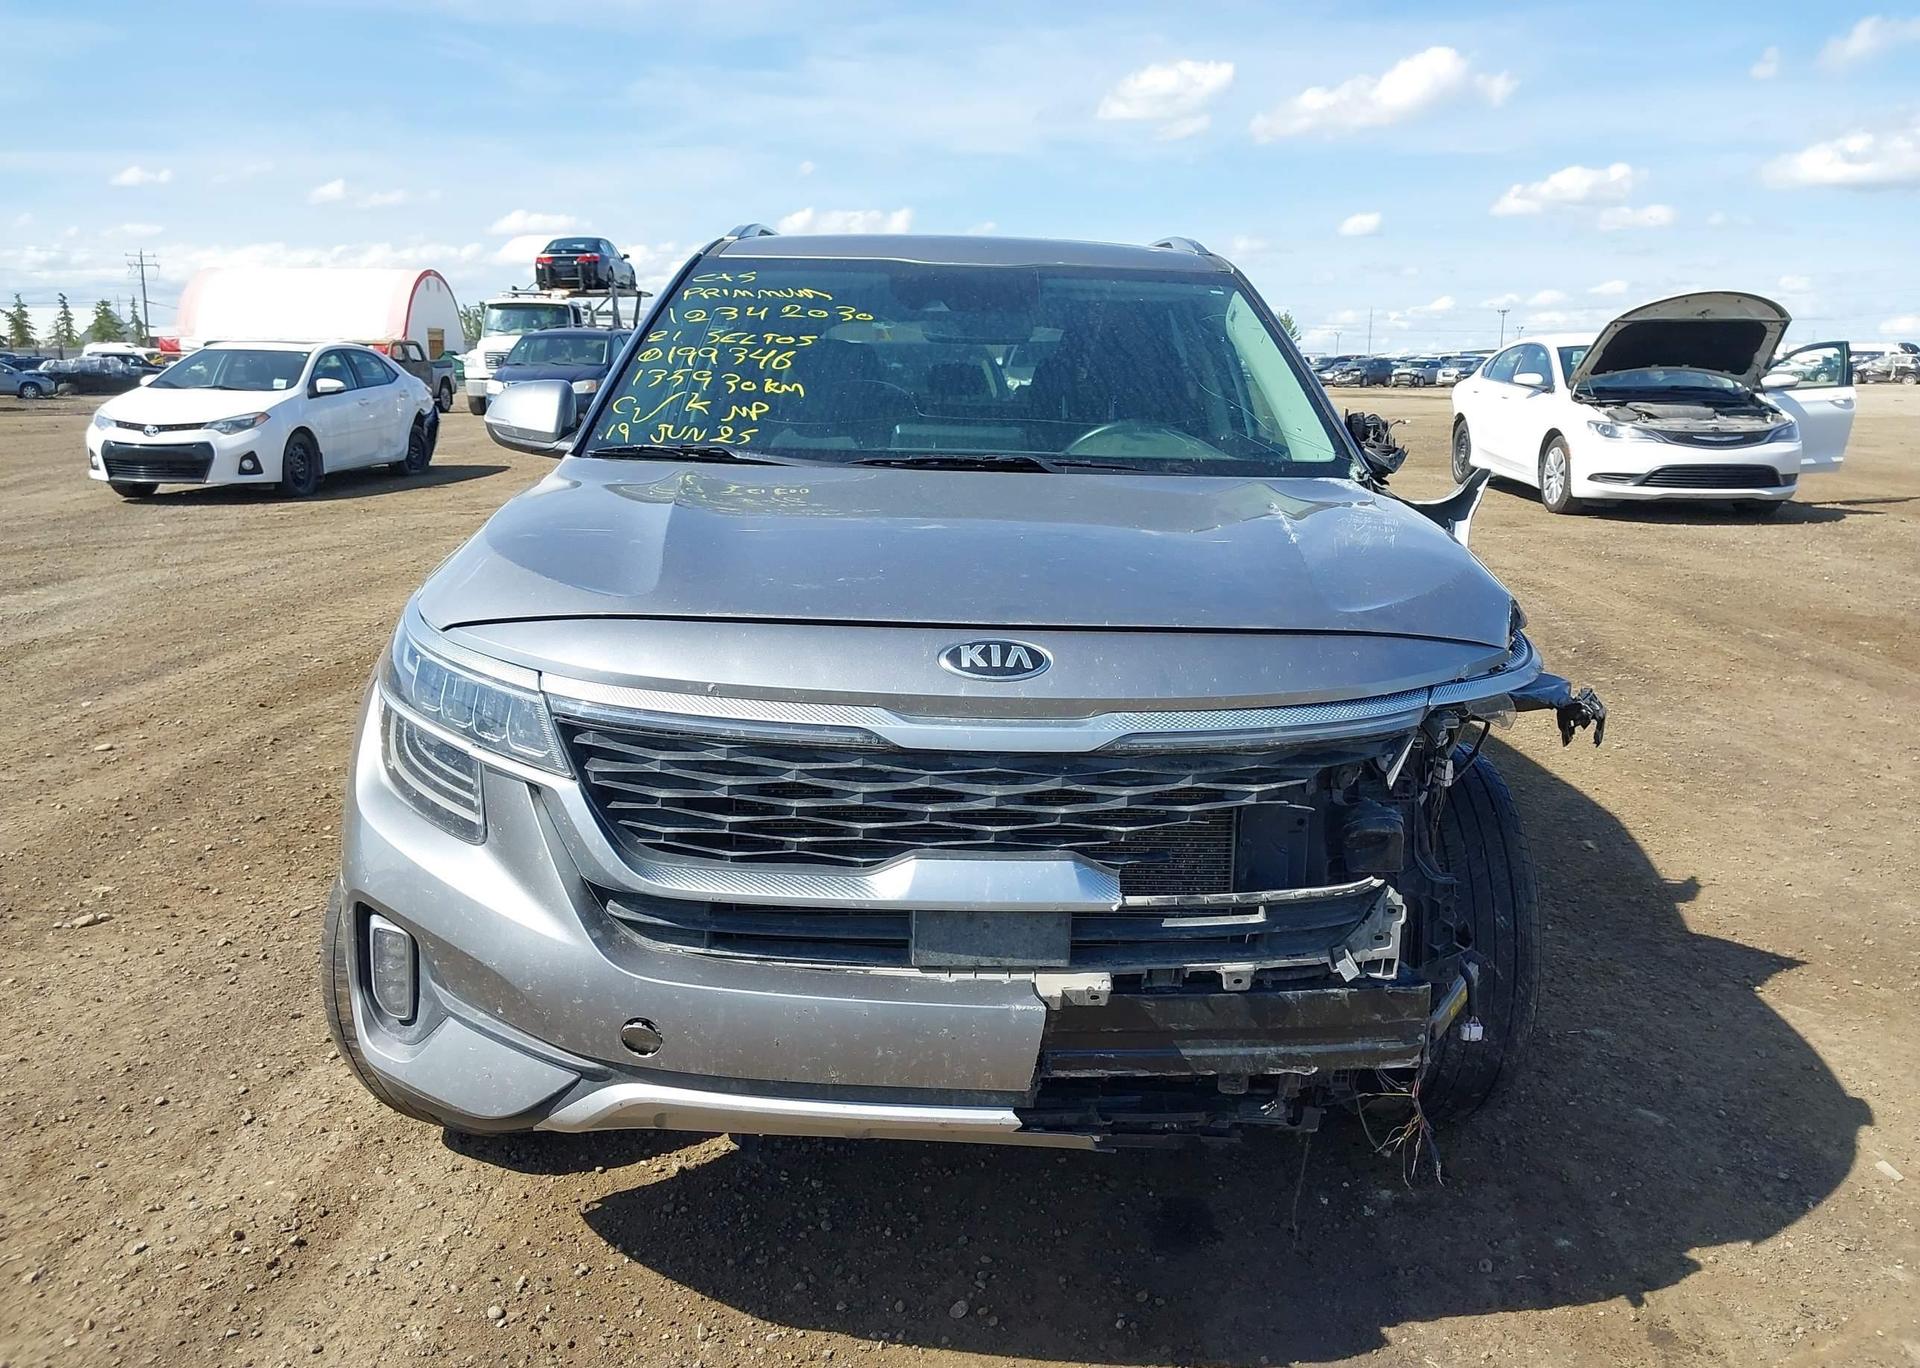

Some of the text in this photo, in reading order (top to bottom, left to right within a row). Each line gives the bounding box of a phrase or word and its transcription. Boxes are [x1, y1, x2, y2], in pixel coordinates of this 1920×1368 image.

[706, 330, 818, 346] SELTOS
[650, 423, 708, 443] JUN
[708, 425, 760, 445] 25
[960, 644, 1033, 669] KIA
